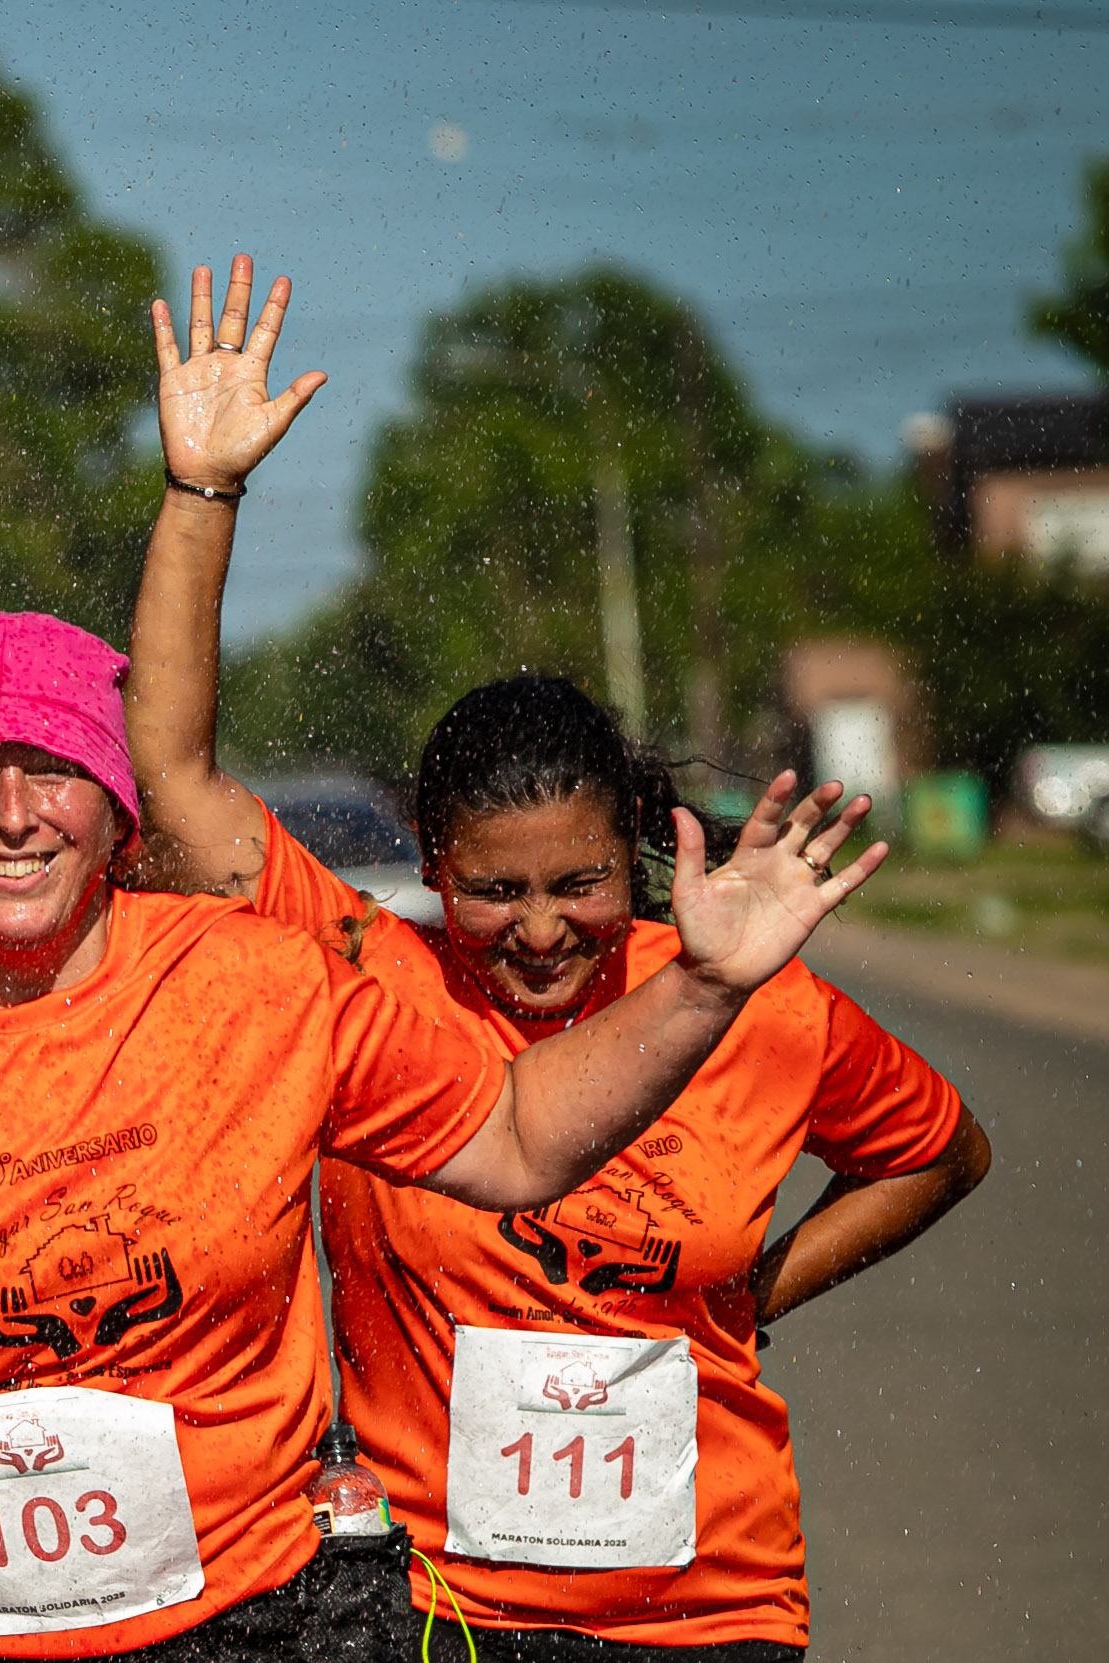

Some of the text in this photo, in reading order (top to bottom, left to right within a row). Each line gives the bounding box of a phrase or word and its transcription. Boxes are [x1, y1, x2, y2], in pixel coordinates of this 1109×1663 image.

[9, 1123, 158, 1186] ANIVERSARIO
[39, 1186, 93, 1222] San
[103, 1183, 183, 1227] Roque
[601, 1166, 704, 1227] an Roque
[500, 1431, 635, 1500] 111
[491, 1532, 628, 1547] MARATON SOLIDARIA 2025
[100, 1591, 127, 1605] 2025
